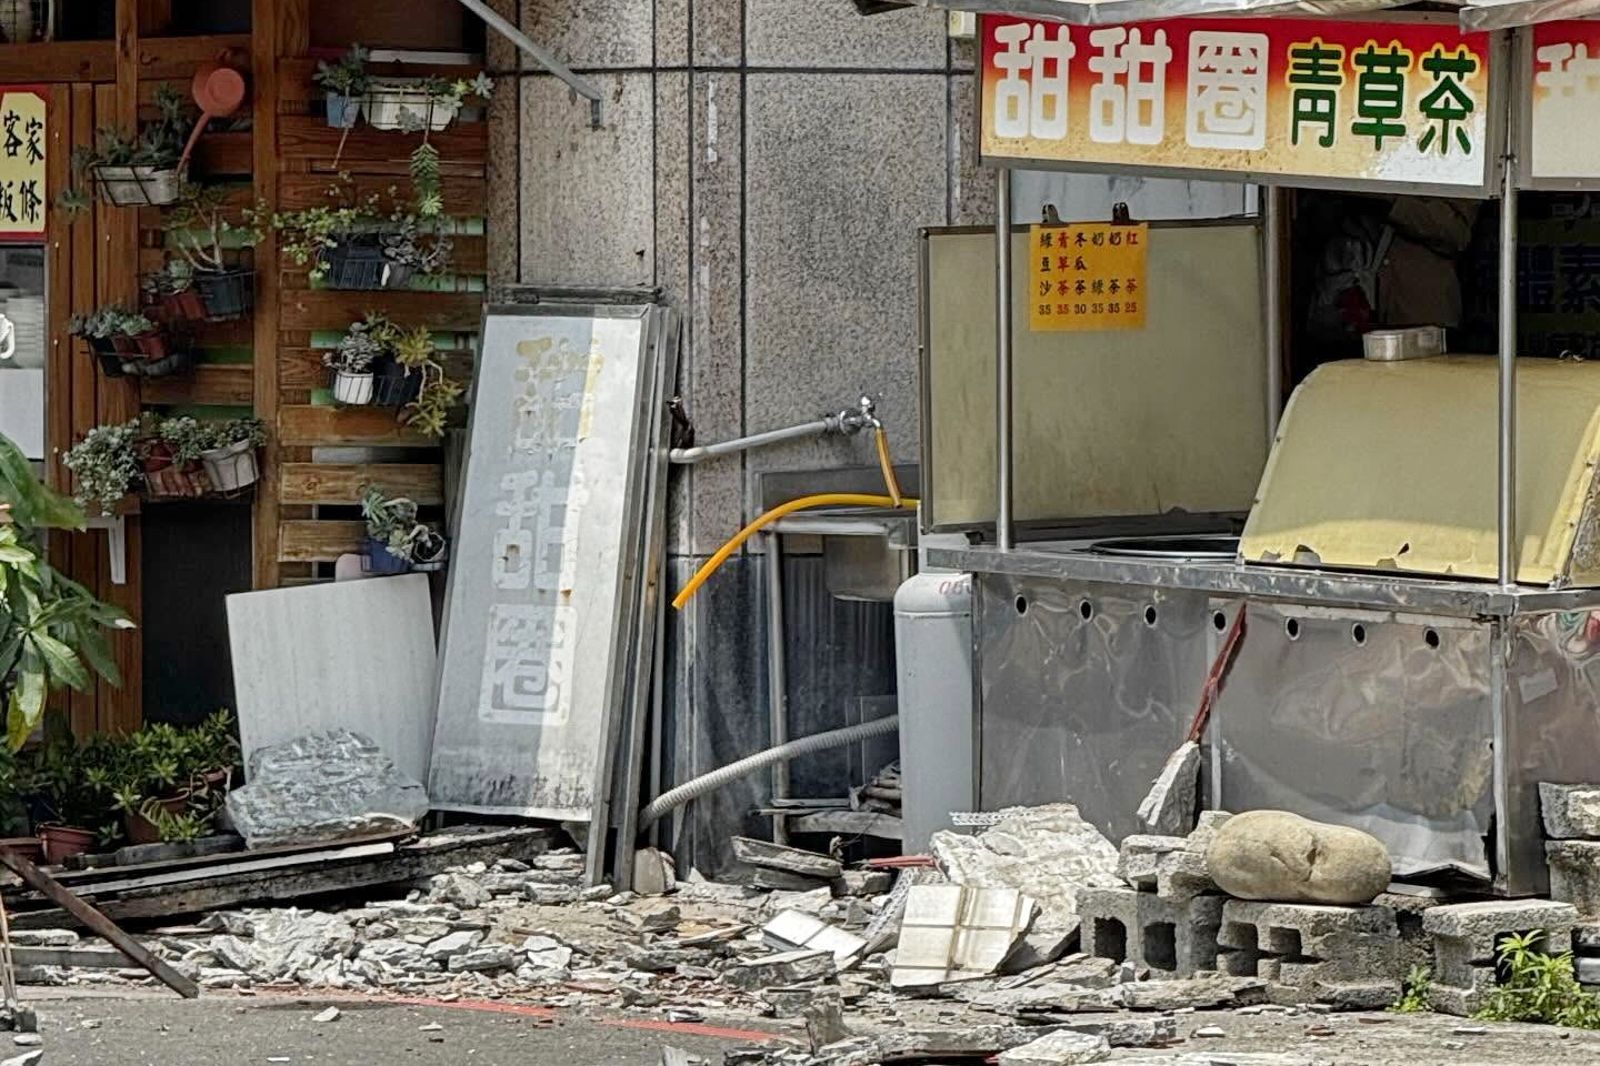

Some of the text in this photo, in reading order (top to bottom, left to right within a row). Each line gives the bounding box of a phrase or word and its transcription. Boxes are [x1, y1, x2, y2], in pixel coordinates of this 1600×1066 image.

[993, 23, 1270, 151] 甜甜圈
[1287, 36, 1479, 157] 青草茶
[3, 110, 44, 165] 客家
[1057, 232, 1070, 296] 青草茶
[1074, 232, 1088, 296] 冬瓜茶
